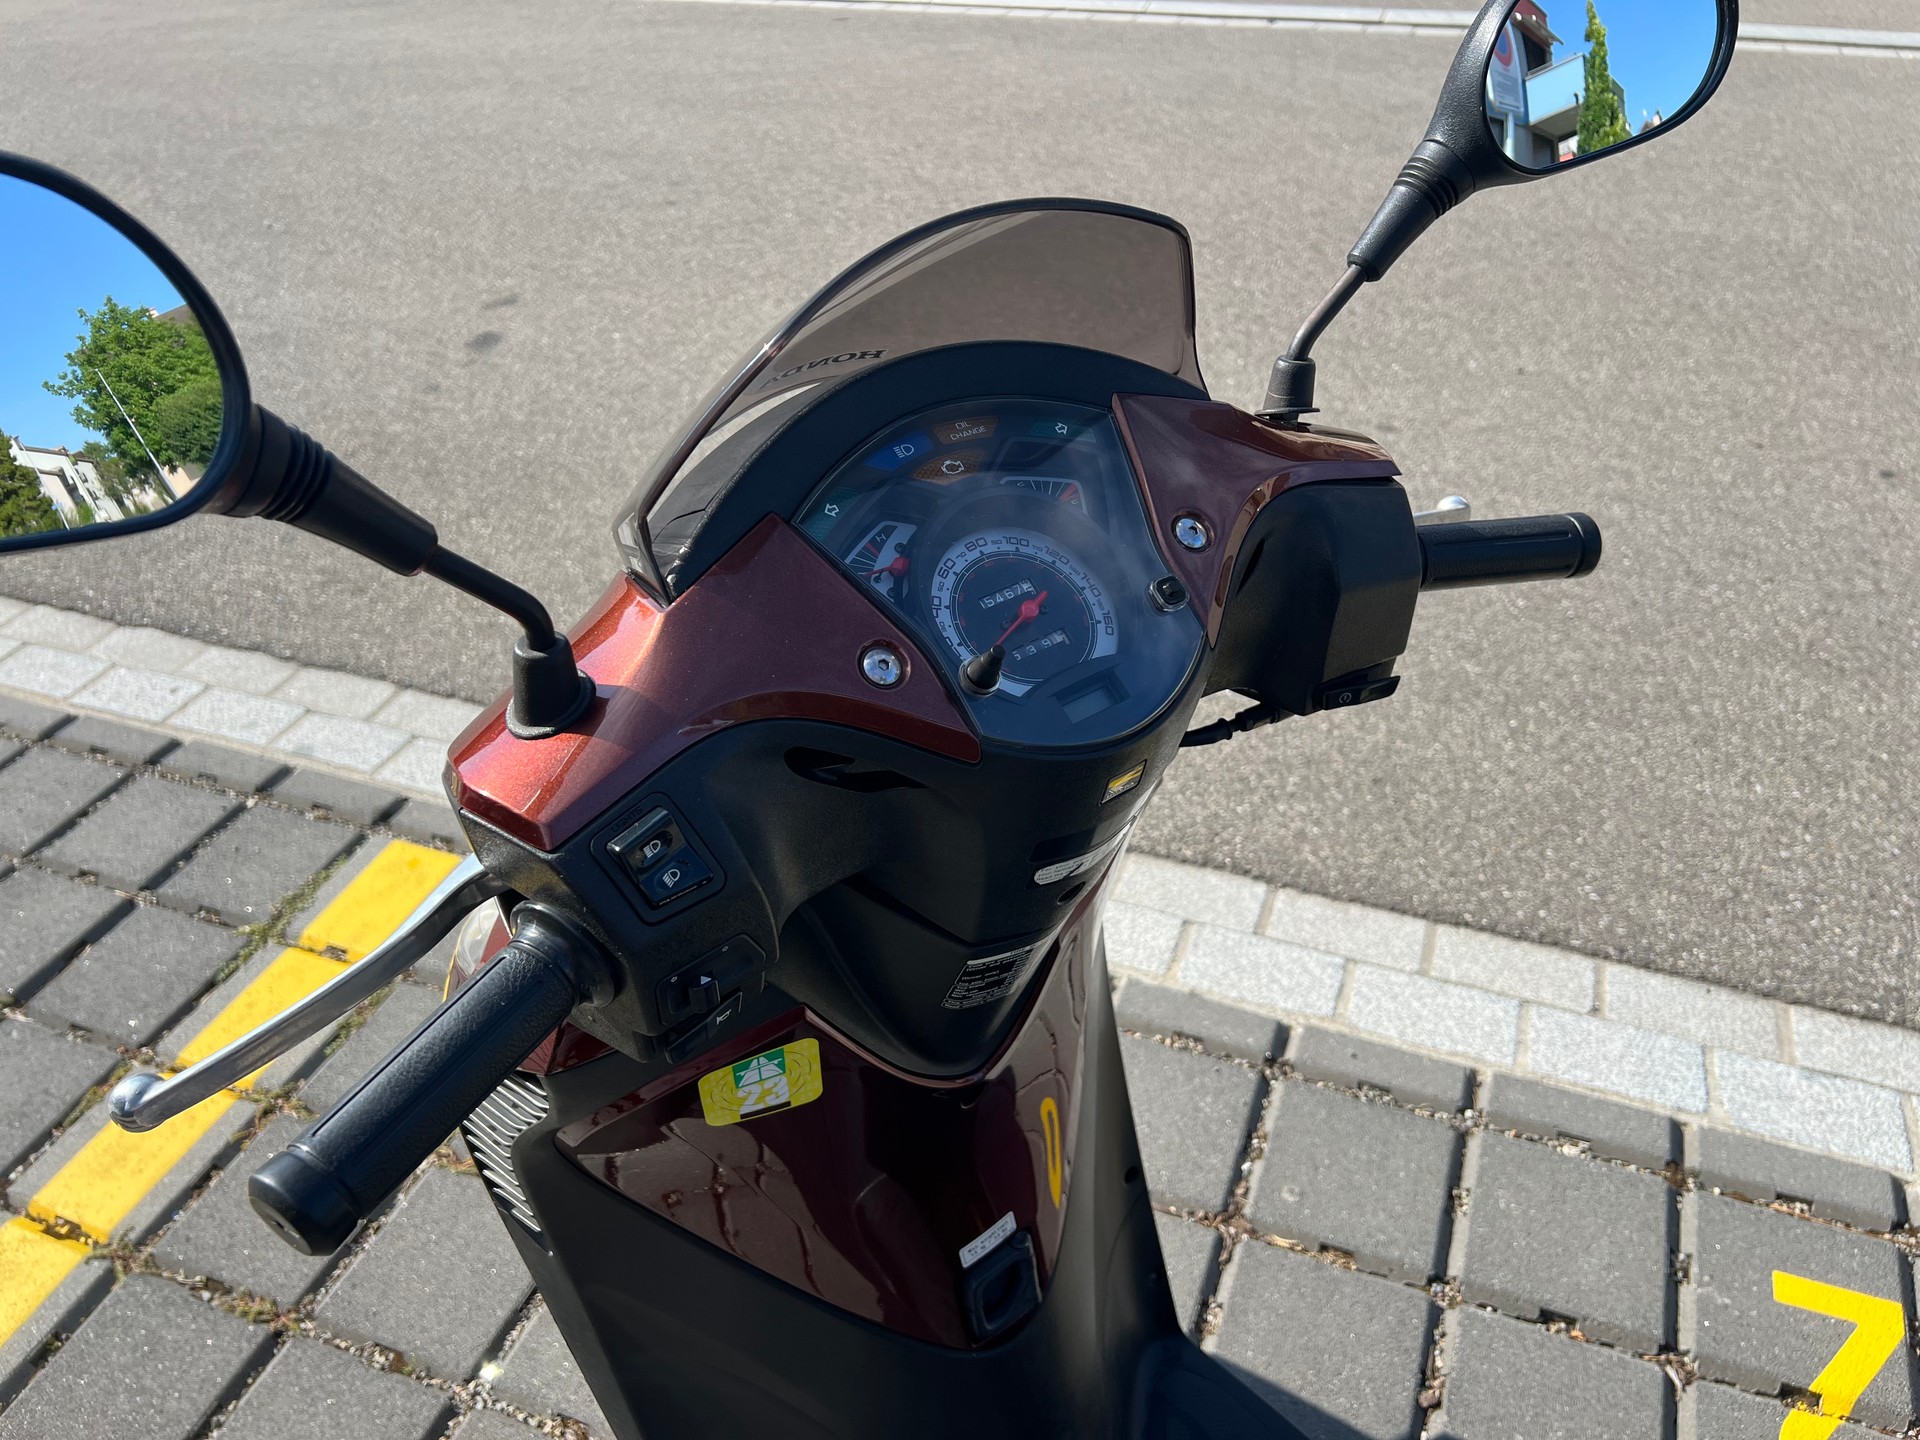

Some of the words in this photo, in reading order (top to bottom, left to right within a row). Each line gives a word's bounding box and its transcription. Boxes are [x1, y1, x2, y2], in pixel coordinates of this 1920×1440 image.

[950, 425, 988, 440] CHANGE
[955, 421, 972, 430] OIL
[965, 537, 988, 552] 80
[1002, 536, 1030, 547] 100
[1044, 545, 1070, 566] 120
[937, 558, 957, 579] 60
[1081, 572, 1102, 598] 140
[1102, 610, 1115, 636] 160
[737, 1076, 790, 1114] 23
[1771, 1269, 1906, 1440] 7
